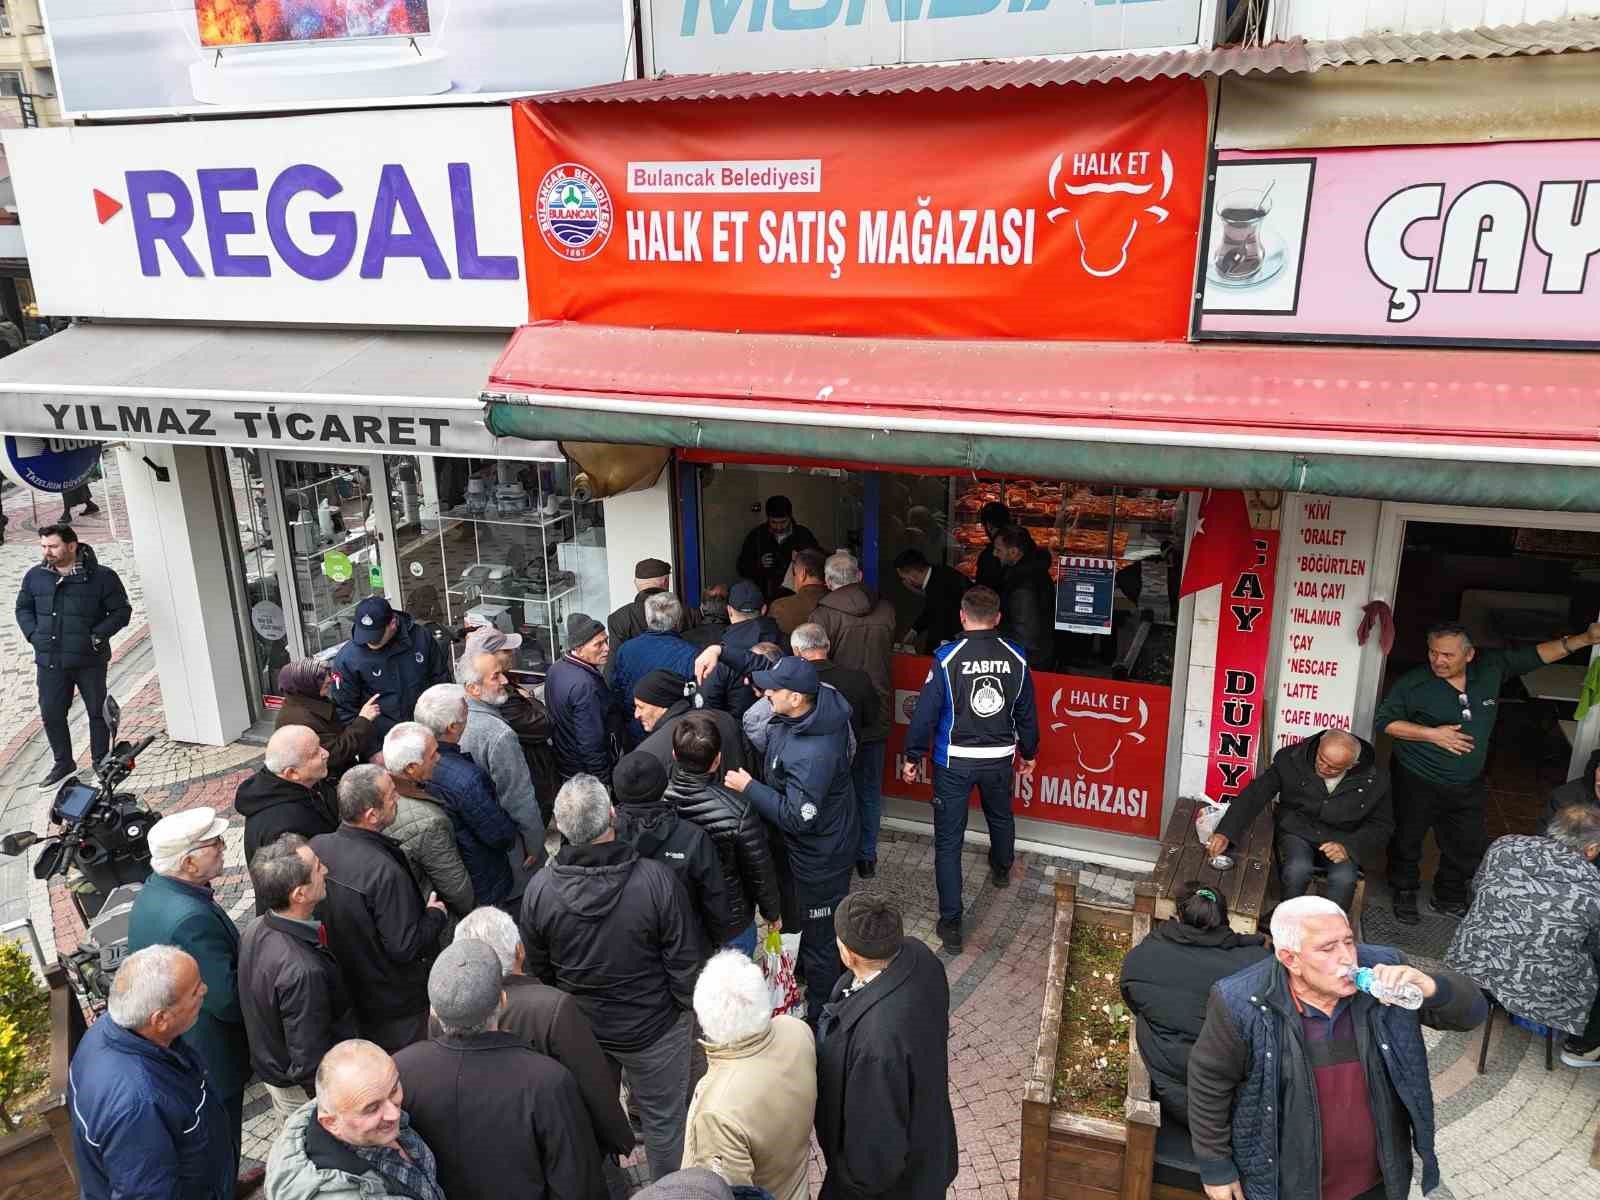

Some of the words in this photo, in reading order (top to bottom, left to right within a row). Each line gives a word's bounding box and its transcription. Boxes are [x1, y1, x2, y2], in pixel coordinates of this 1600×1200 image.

[1073, 153, 1122, 176] HALK
[1128, 152, 1150, 175] ET
[633, 168, 715, 187] Bulancak
[721, 166, 816, 189] Belediyesi
[124, 162, 520, 281] REGAL
[549, 208, 599, 219] BULANCAK
[625, 210, 703, 262] HALK
[712, 210, 749, 263] ET
[758, 210, 848, 279] SATIŞ
[856, 195, 1036, 266] MAĞAZASI
[1364, 179, 1600, 323] ÇAY
[43, 403, 217, 436] YILMAZ
[234, 405, 450, 447] TİCARET
[1307, 500, 1332, 520] KİVİ
[1303, 528, 1346, 546] ORALET
[1300, 553, 1365, 576] BÖĞÜRTLEN
[1296, 582, 1318, 598] ADA
[1320, 582, 1345, 602] ÇAYI
[1293, 607, 1342, 626] IHLAMUR
[1292, 634, 1314, 653] ÇAY
[961, 659, 1011, 675] ZABITA
[1290, 658, 1338, 677] NESCAFE
[1070, 690, 1108, 708] HALK
[1112, 695, 1131, 712] ET
[1286, 682, 1319, 700] LATTE
[1284, 709, 1311, 726] CAFE
[1313, 711, 1350, 730] MOCHA
[1040, 773, 1148, 819] MAĞAZASI
